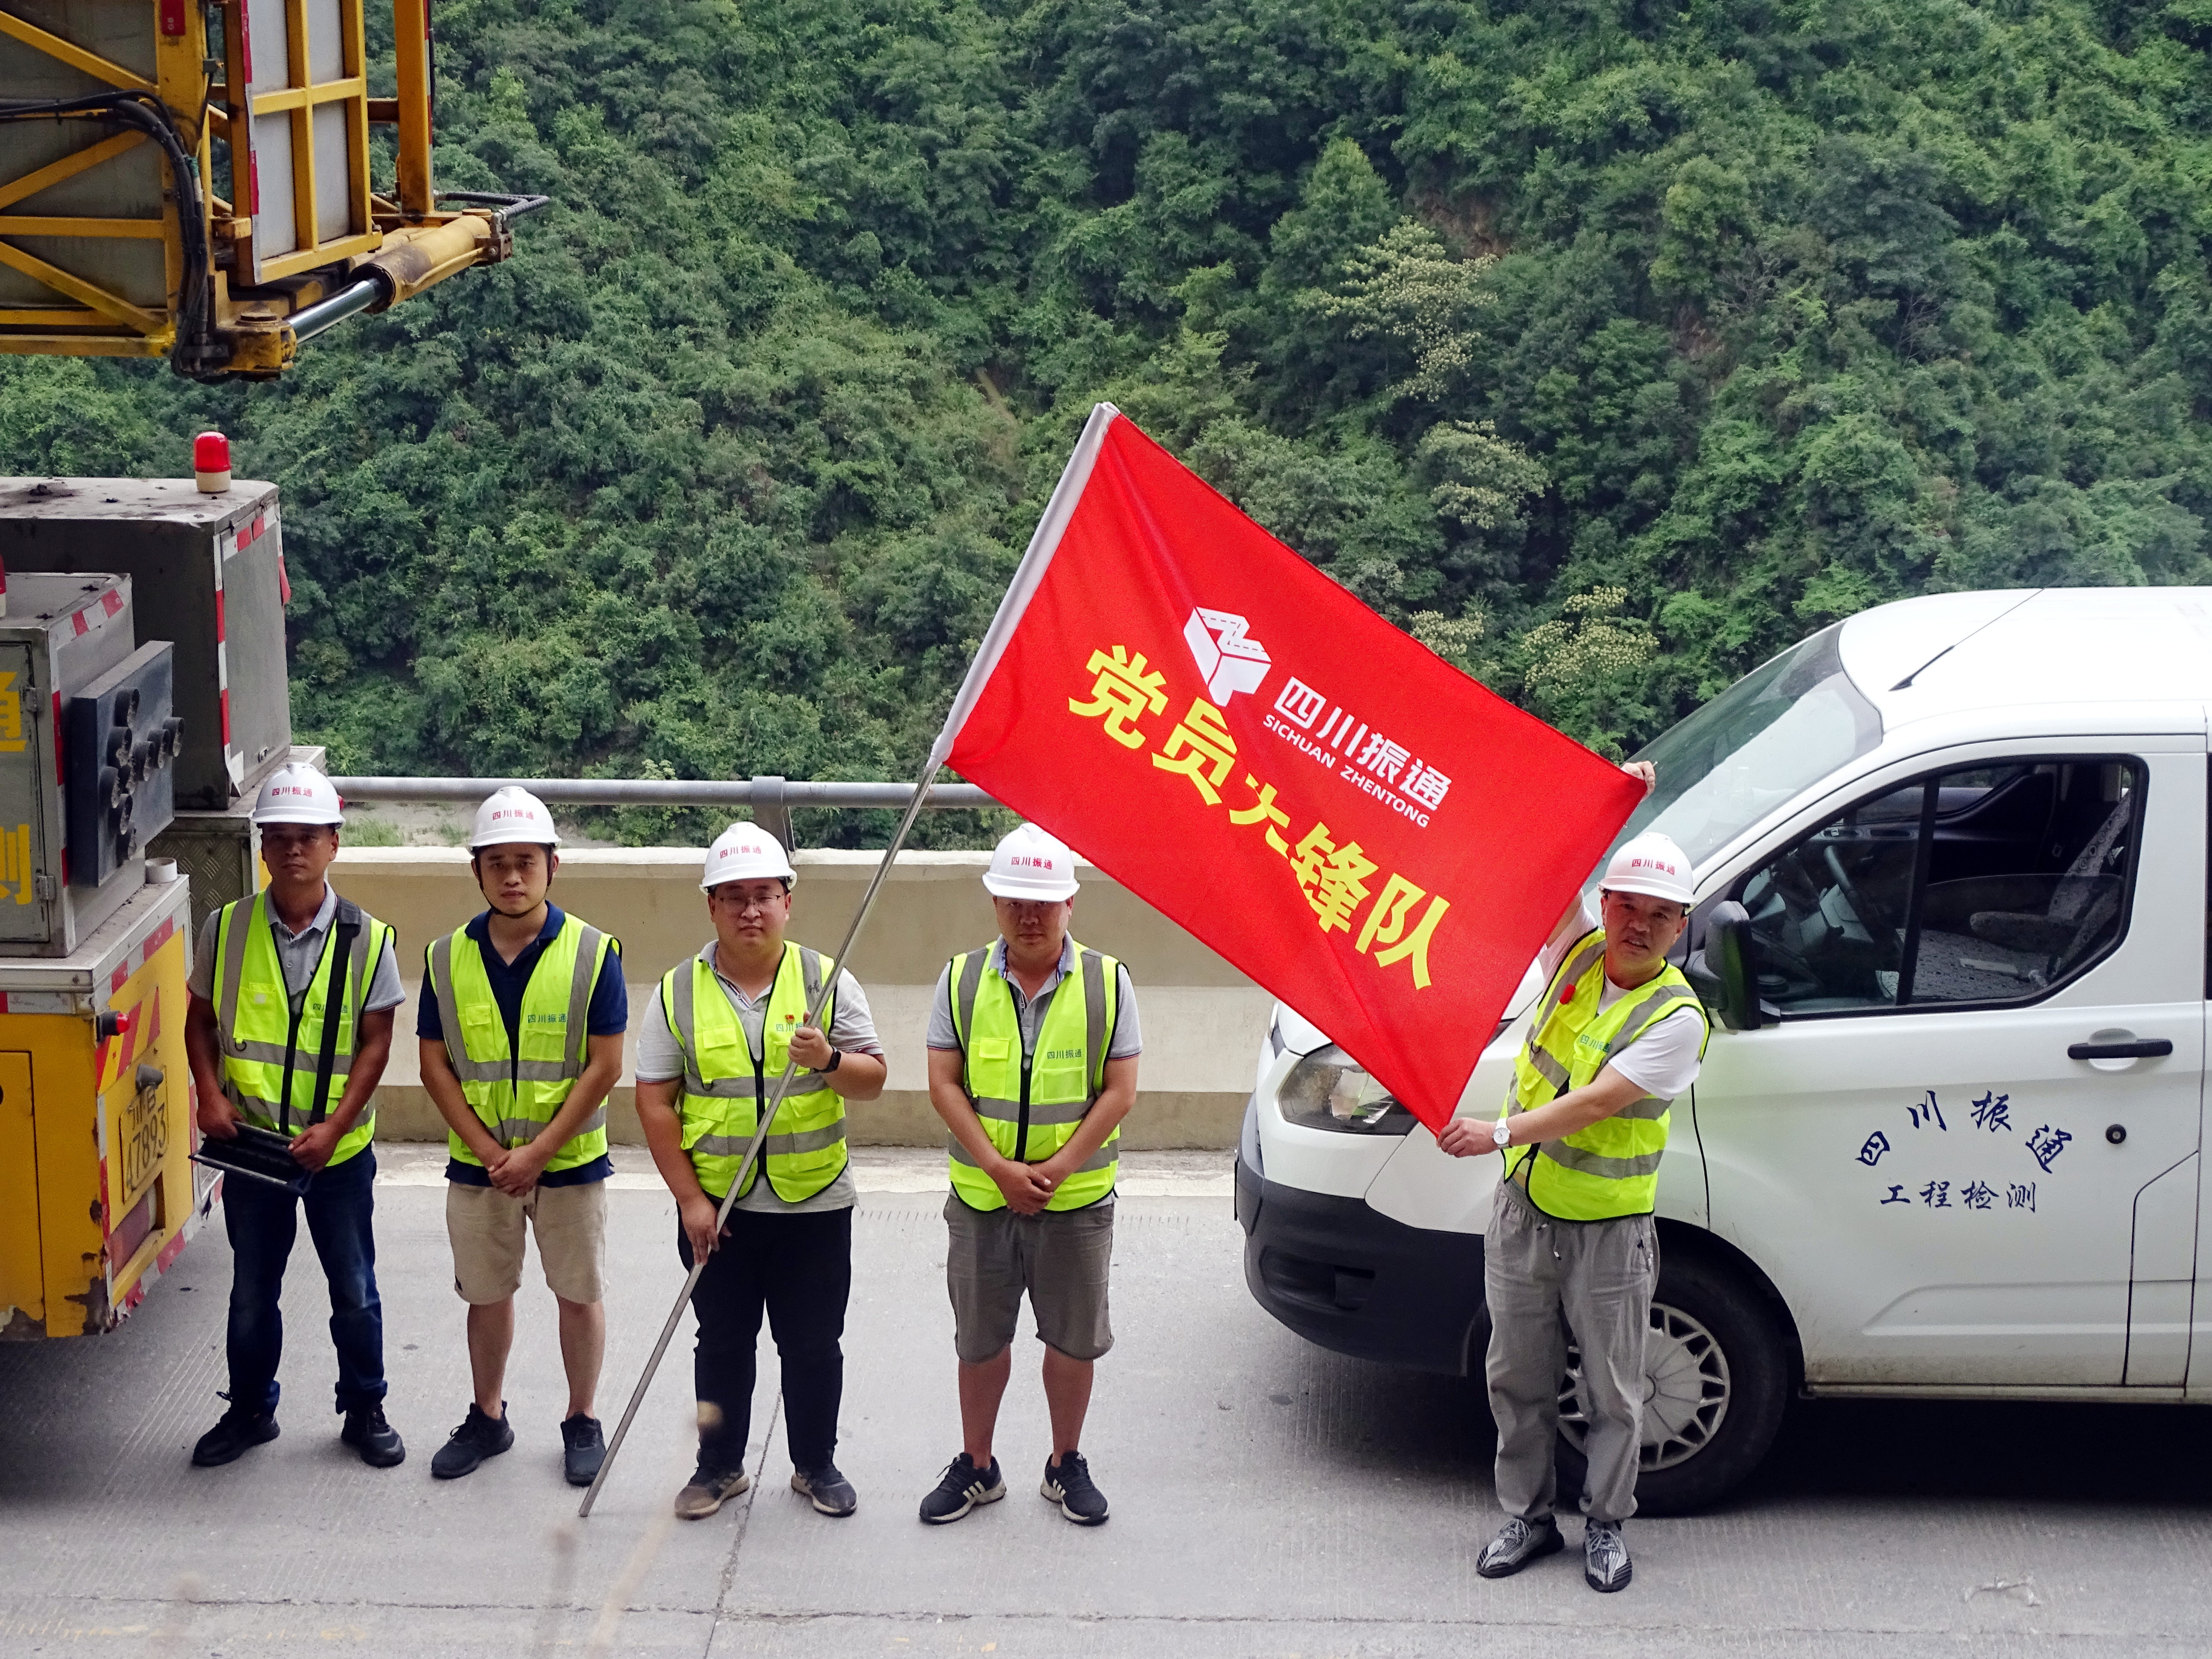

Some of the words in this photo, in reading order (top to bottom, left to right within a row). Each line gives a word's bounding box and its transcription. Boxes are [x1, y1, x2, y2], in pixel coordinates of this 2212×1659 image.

[1274, 676, 1452, 811] 四川振通
[1263, 714, 1336, 769] SICHUAN
[1340, 765, 1430, 828] ZHENTONG
[271, 786, 313, 797] 四川振通
[492, 809, 534, 821] 四川振通
[720, 845, 762, 859] 四川振通
[1011, 856, 1053, 870] 四川振通
[1631, 859, 1676, 876] 四川振通
[528, 1013, 566, 1024] 四川振通
[1047, 1049, 1082, 1059] 四川振通
[1854, 1090, 2073, 1174] 四川振通
[1880, 1179, 2037, 1213] 工程检测
